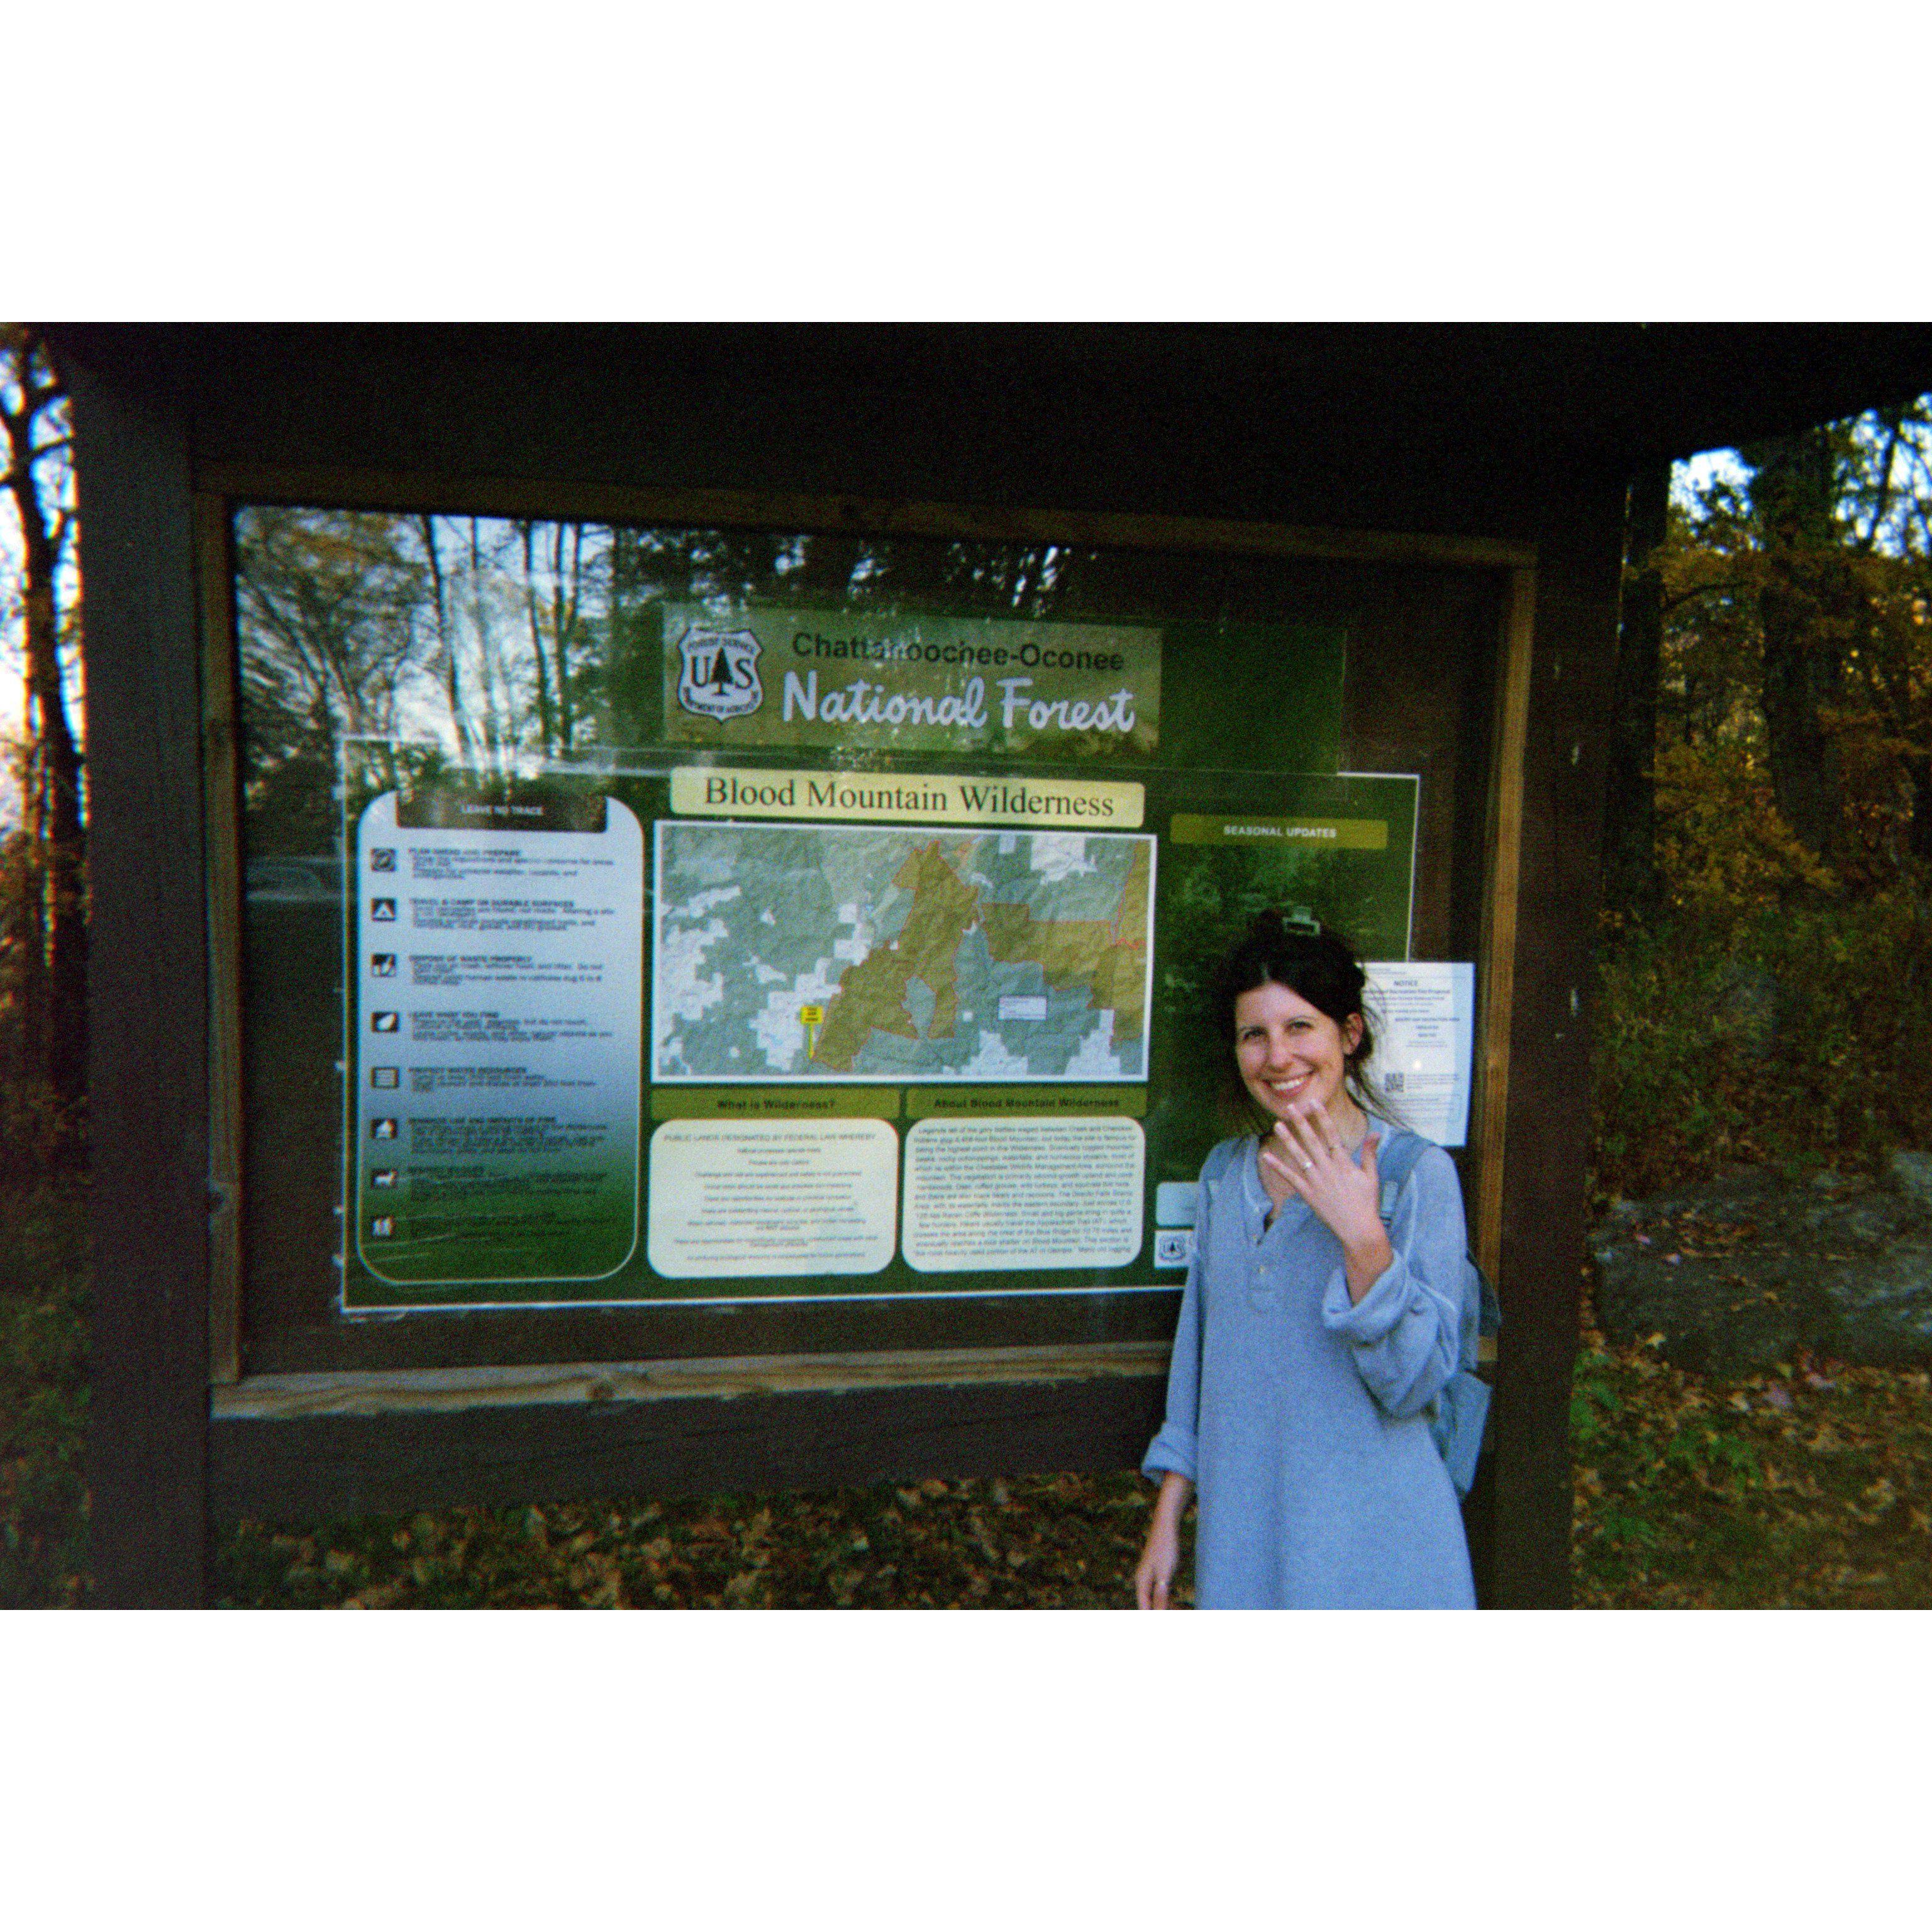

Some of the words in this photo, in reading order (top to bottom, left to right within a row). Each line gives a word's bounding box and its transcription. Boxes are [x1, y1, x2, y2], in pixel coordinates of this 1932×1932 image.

[782, 670, 988, 728] National
[996, 677, 1136, 733] Forest
[706, 778, 796, 807] Blood
[808, 780, 947, 812] Mountain
[959, 784, 1114, 818] Wilderness
[1223, 825, 1283, 837] SEASONAL
[1286, 826, 1337, 838] UPDATES
[1393, 979, 1419, 987] NOTICE
[718, 1099, 747, 1109] What
[763, 1098, 835, 1109] Wilderness?
[935, 1099, 967, 1109] About
[970, 1099, 1002, 1109] Blood
[1006, 1098, 1056, 1108] Mountain
[1058, 1098, 1119, 1108] Wilderness
